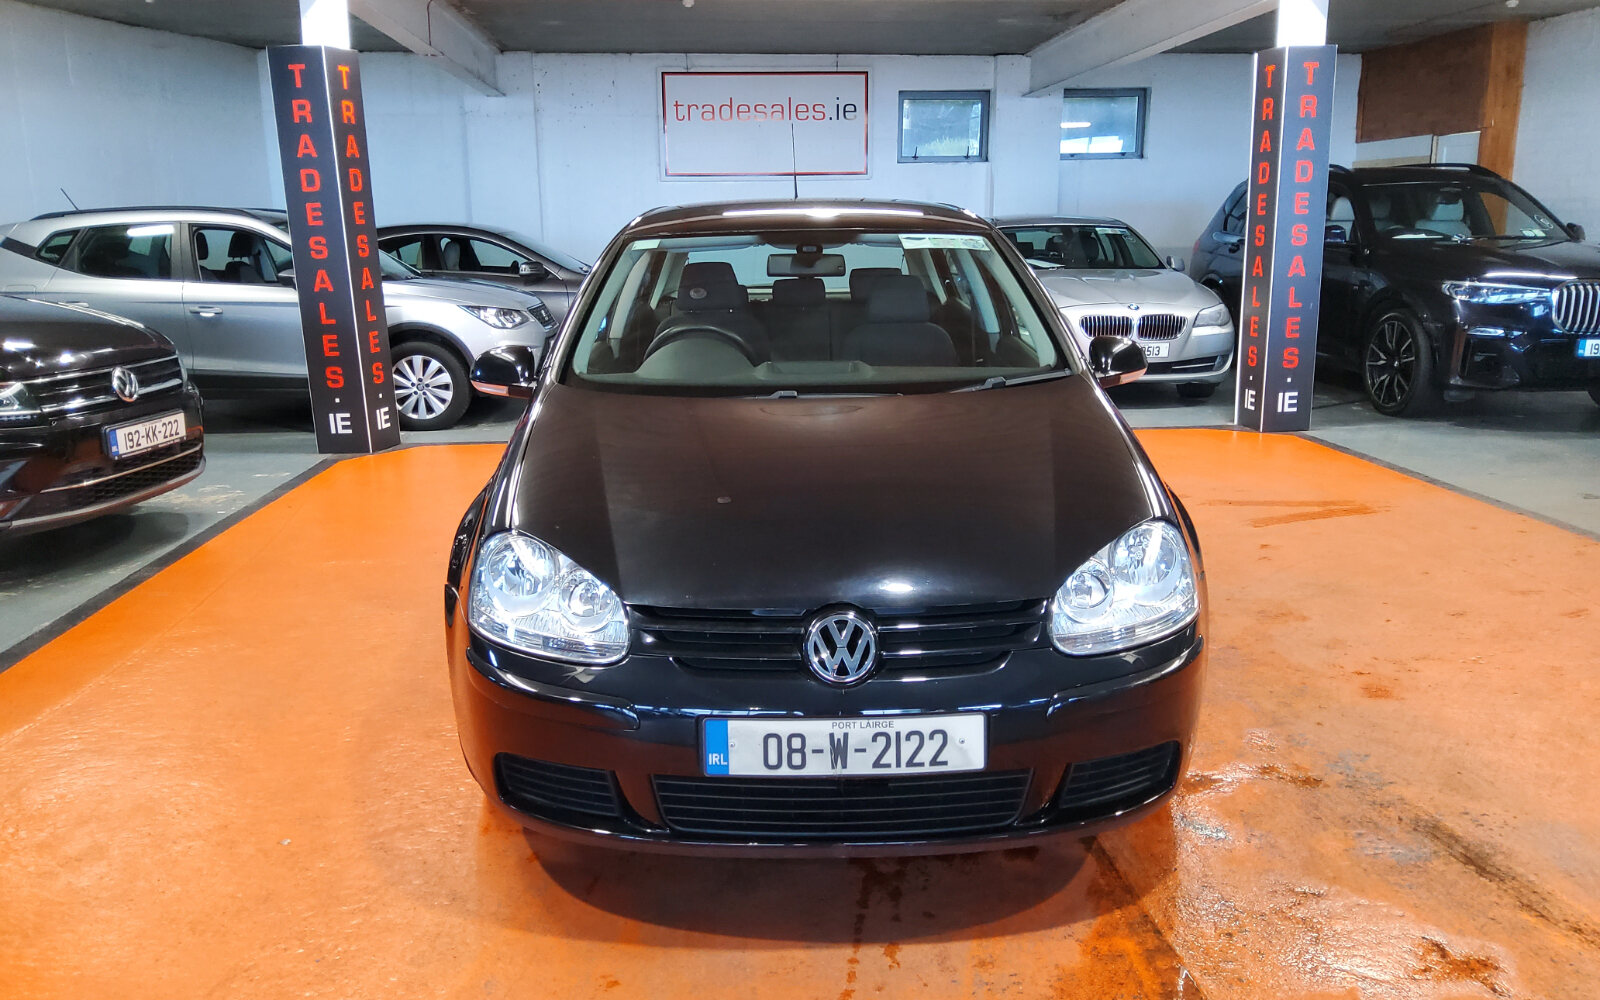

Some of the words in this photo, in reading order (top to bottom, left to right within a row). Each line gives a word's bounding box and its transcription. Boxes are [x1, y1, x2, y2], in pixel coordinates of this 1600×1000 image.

[673, 97, 857, 122] tradesales.ie
[1589, 343, 1600, 355] 19
[123, 419, 180, 451] 192-KK-222
[807, 614, 876, 682] VW
[831, 721, 857, 730] PORT
[708, 753, 728, 766] IRL
[762, 729, 949, 771] 08-W-2122
